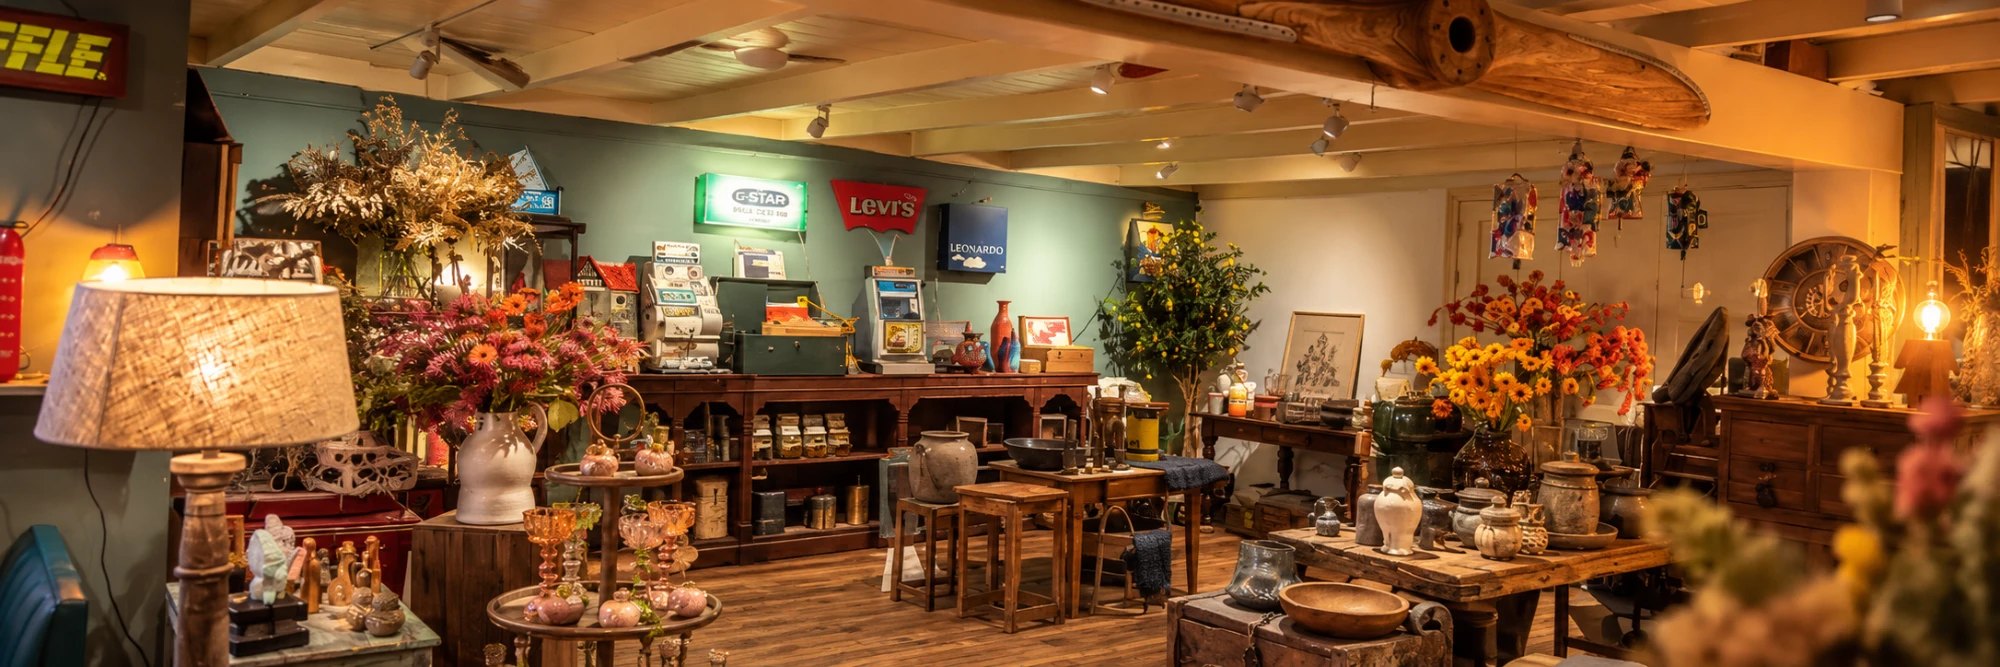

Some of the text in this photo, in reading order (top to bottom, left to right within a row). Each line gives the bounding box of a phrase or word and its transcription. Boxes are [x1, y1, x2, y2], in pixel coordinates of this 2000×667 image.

[735, 191, 786, 205] G-STAR
[850, 196, 915, 218] Levi's
[950, 242, 1004, 255] LEONARDO
